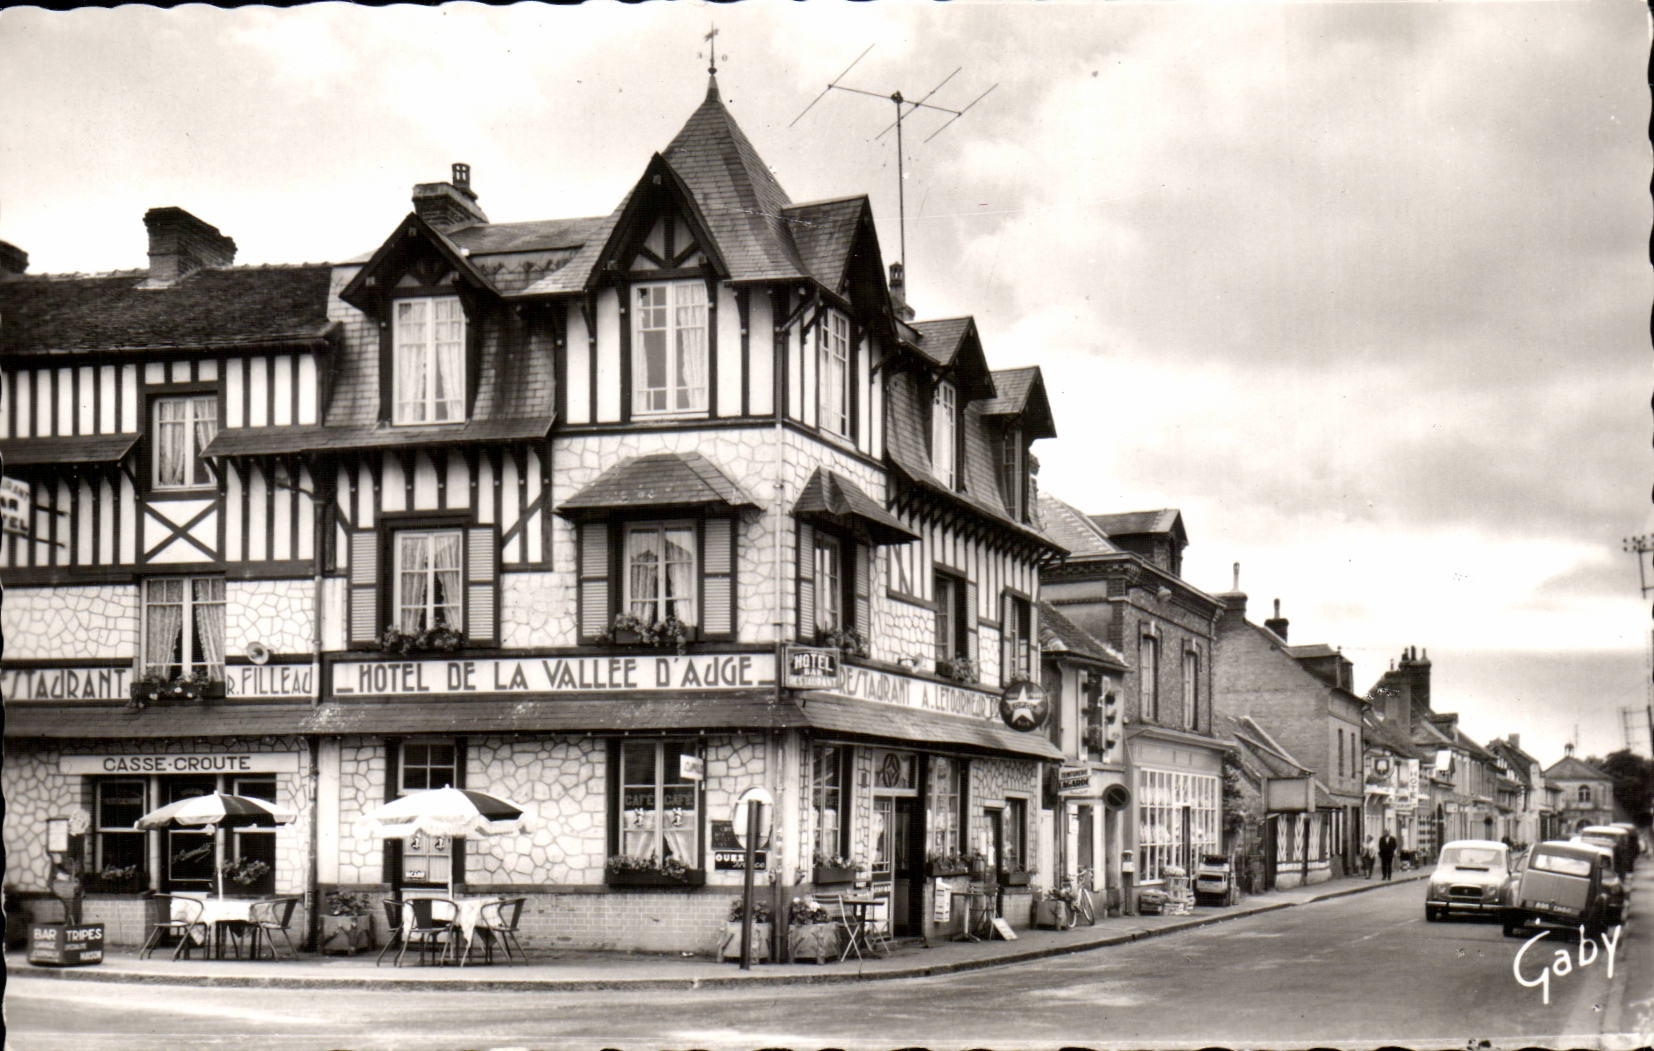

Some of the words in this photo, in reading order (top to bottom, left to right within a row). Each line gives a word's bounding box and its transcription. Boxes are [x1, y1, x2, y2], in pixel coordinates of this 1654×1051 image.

[794, 653, 833, 671] HOTEL
[358, 662, 429, 693] HOTEL
[447, 660, 476, 691] DE
[495, 659, 528, 690] LA
[656, 656, 753, 687] D'AUGE
[804, 669, 823, 677] BAR
[839, 665, 911, 705] RESTAURANT
[34, 928, 57, 940] BAR
[65, 928, 102, 942] TRIPES
